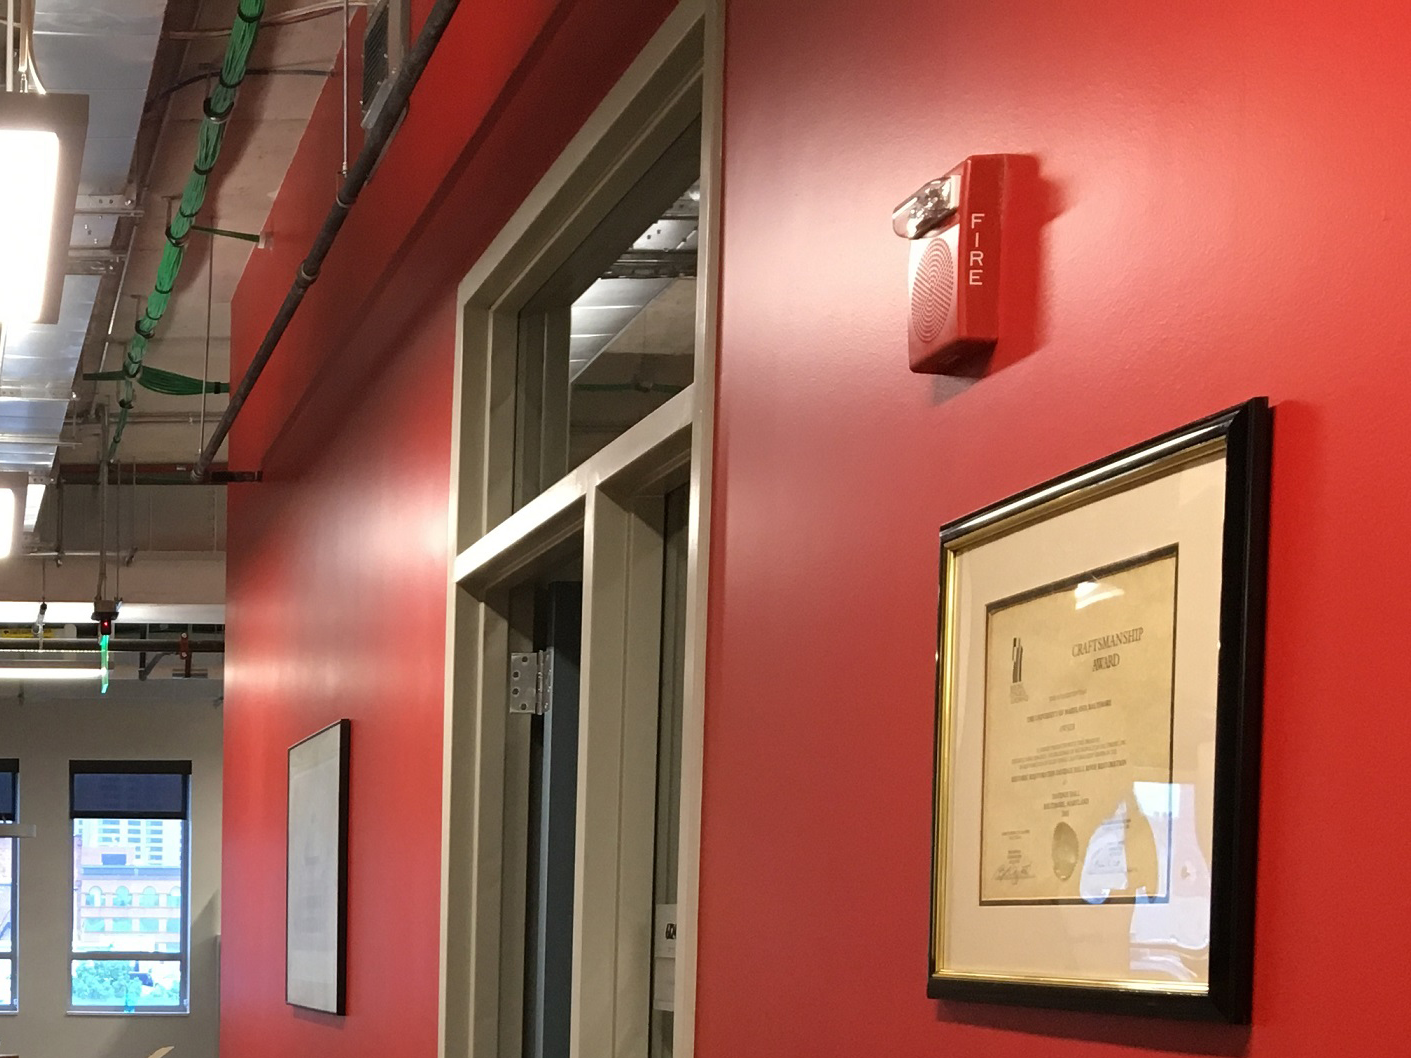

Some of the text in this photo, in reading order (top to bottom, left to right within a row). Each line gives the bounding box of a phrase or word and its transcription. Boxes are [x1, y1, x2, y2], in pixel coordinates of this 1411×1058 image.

[969, 213, 985, 285] FIRE
[1071, 626, 1144, 658] CRAFTSMANSHIP
[1091, 652, 1121, 673] AWARD
